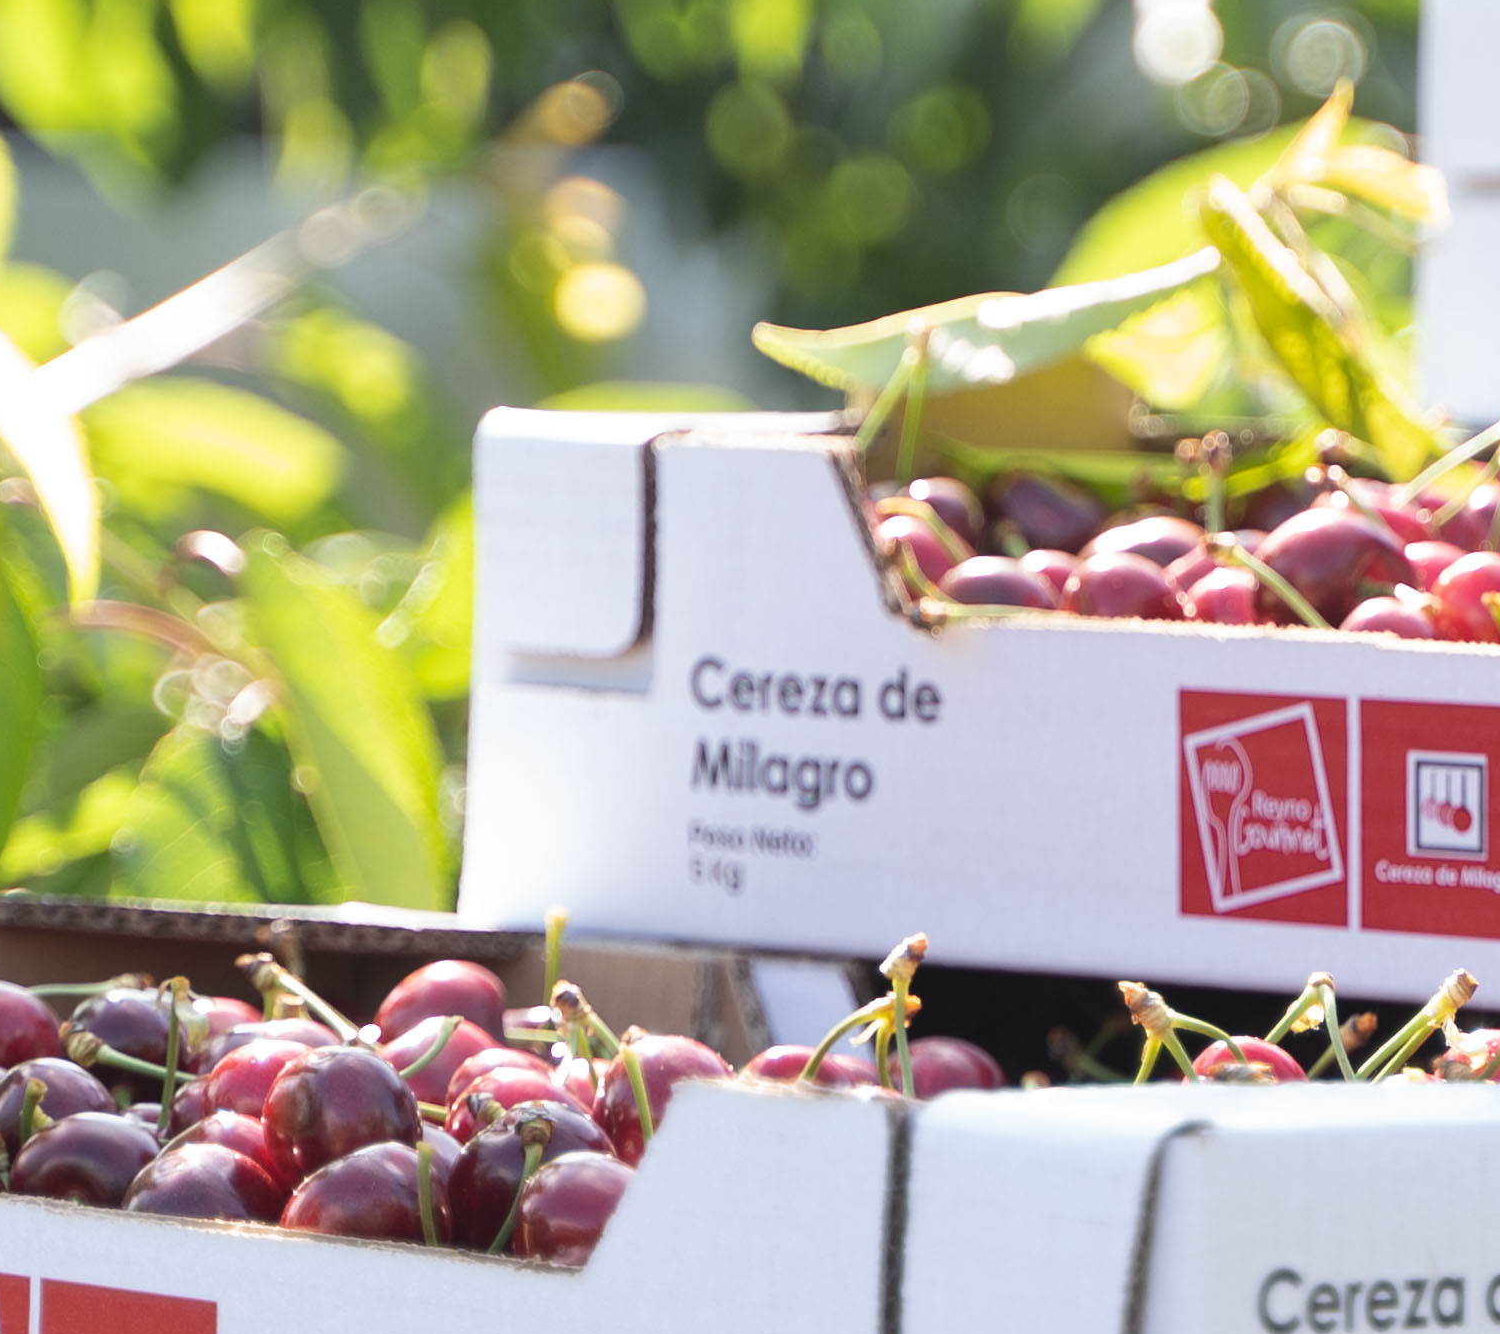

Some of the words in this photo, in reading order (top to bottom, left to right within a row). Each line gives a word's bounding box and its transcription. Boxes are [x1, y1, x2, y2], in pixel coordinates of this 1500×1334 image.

[689, 656, 862, 719] Cereza
[879, 666, 943, 724] de
[689, 736, 875, 812] Milagro
